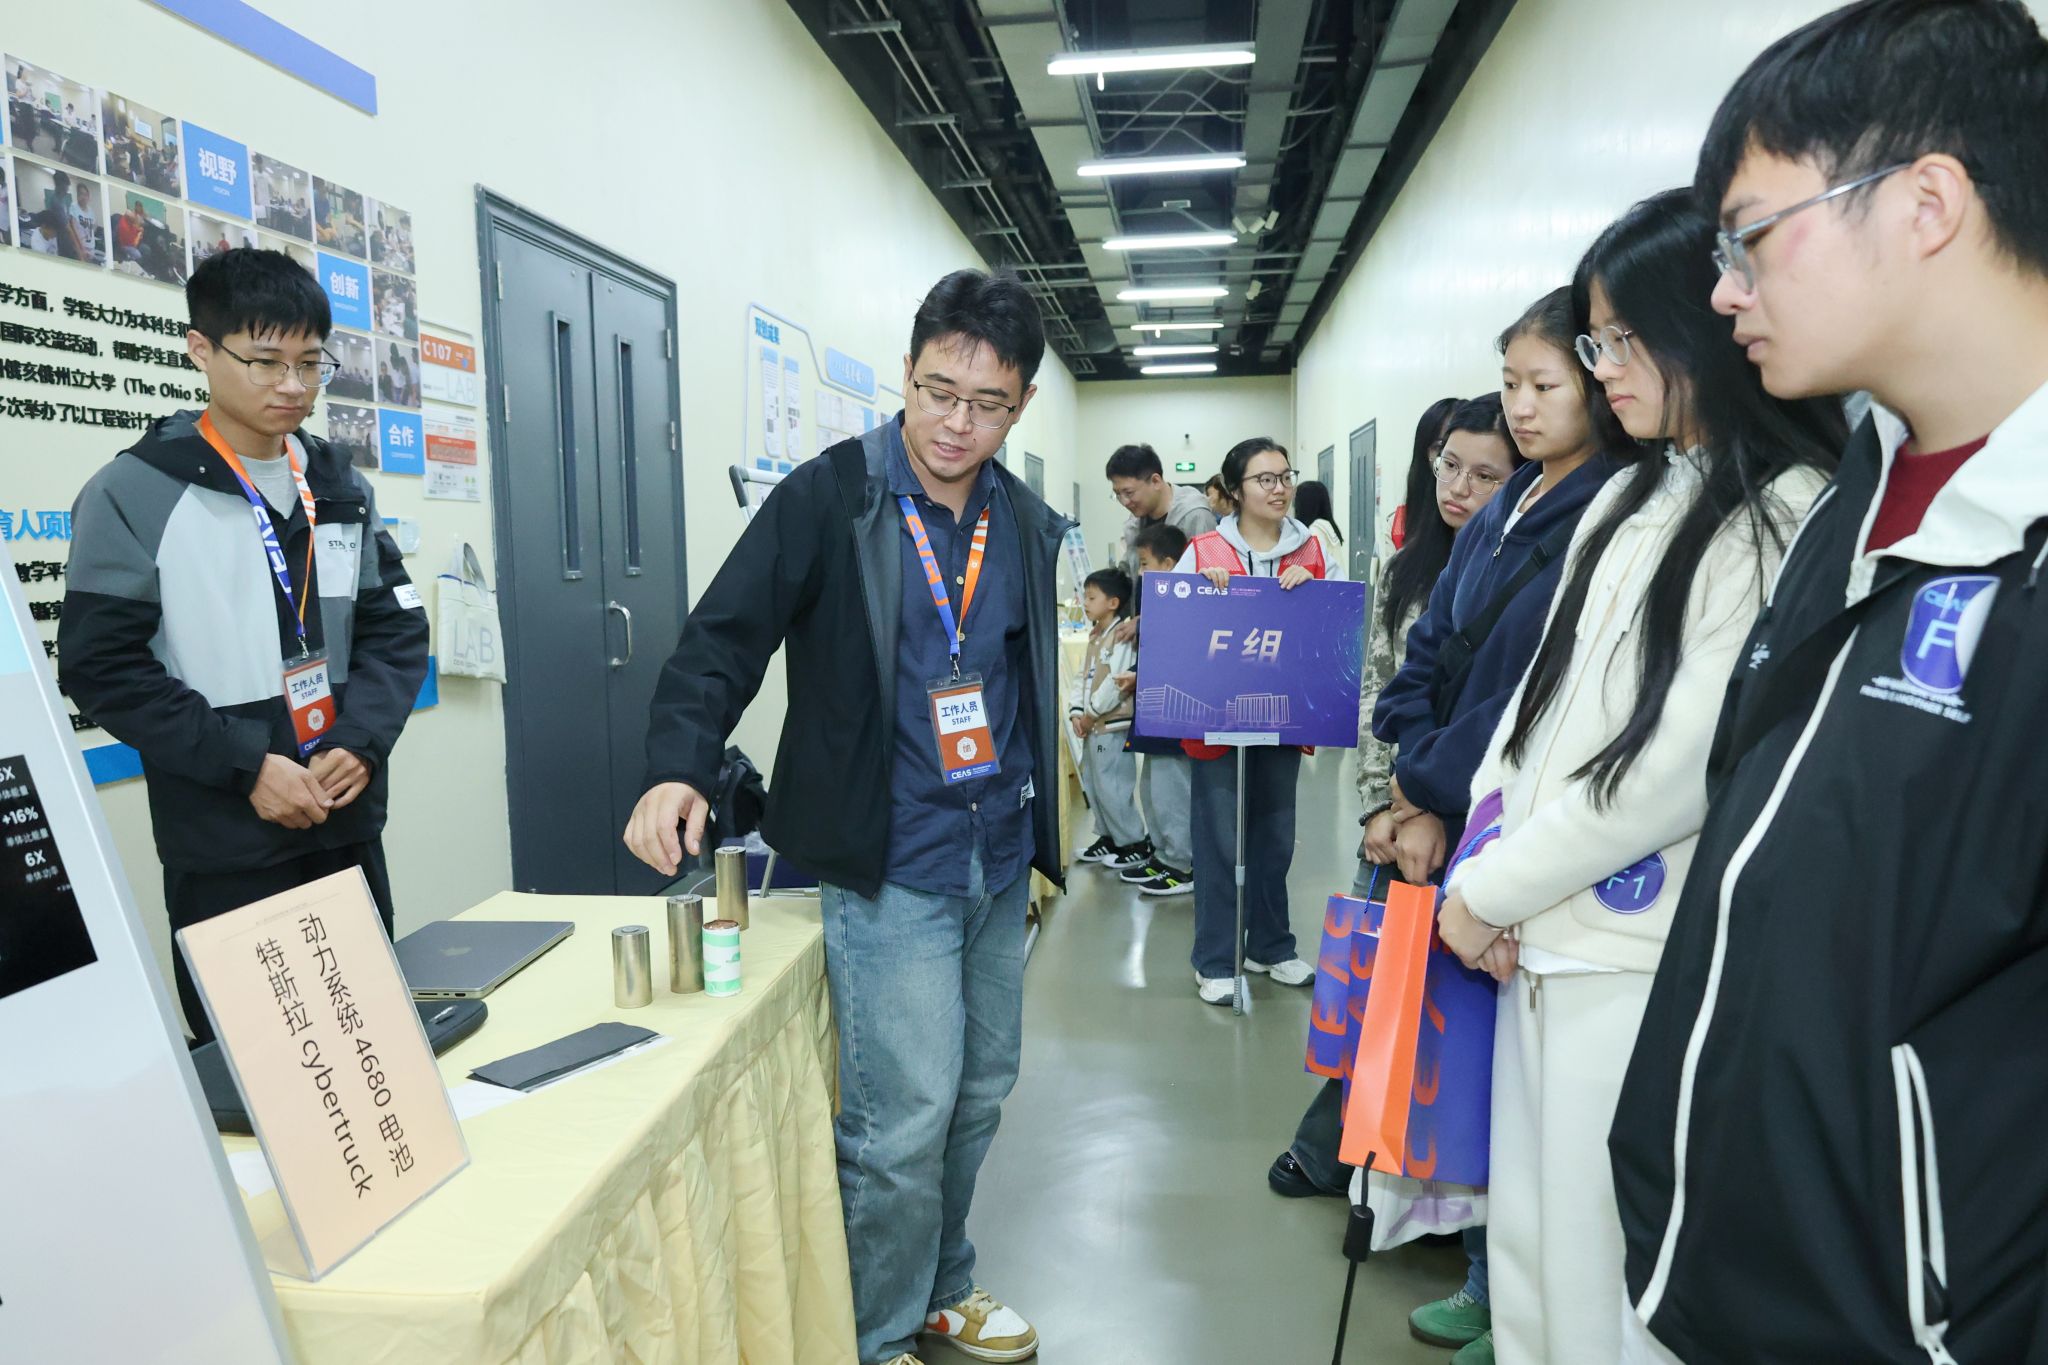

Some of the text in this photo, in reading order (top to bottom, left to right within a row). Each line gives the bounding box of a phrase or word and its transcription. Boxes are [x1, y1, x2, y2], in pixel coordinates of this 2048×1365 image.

[198, 147, 237, 186] 视野
[330, 271, 359, 300] 创新
[423, 340, 452, 361] C107
[0, 358, 116, 392] 俄亥俄州立大学
[160, 383, 191, 400] Ohio
[388, 424, 415, 447] 合作
[1197, 586, 1228, 596] CEAS
[1207, 627, 1283, 664] F 组
[291, 673, 324, 694] 工作人员
[301, 687, 318, 700] STAFF
[941, 701, 979, 718] 工作人员
[951, 715, 972, 726] STAFF
[951, 769, 972, 780] CEAS
[2, 806, 39, 825] +16%
[25, 850, 46, 868] 6X
[298, 912, 415, 1179] 动力系统 4680 电池
[255, 937, 314, 1037] 特斯拉
[301, 1039, 374, 1200] cybertruck
